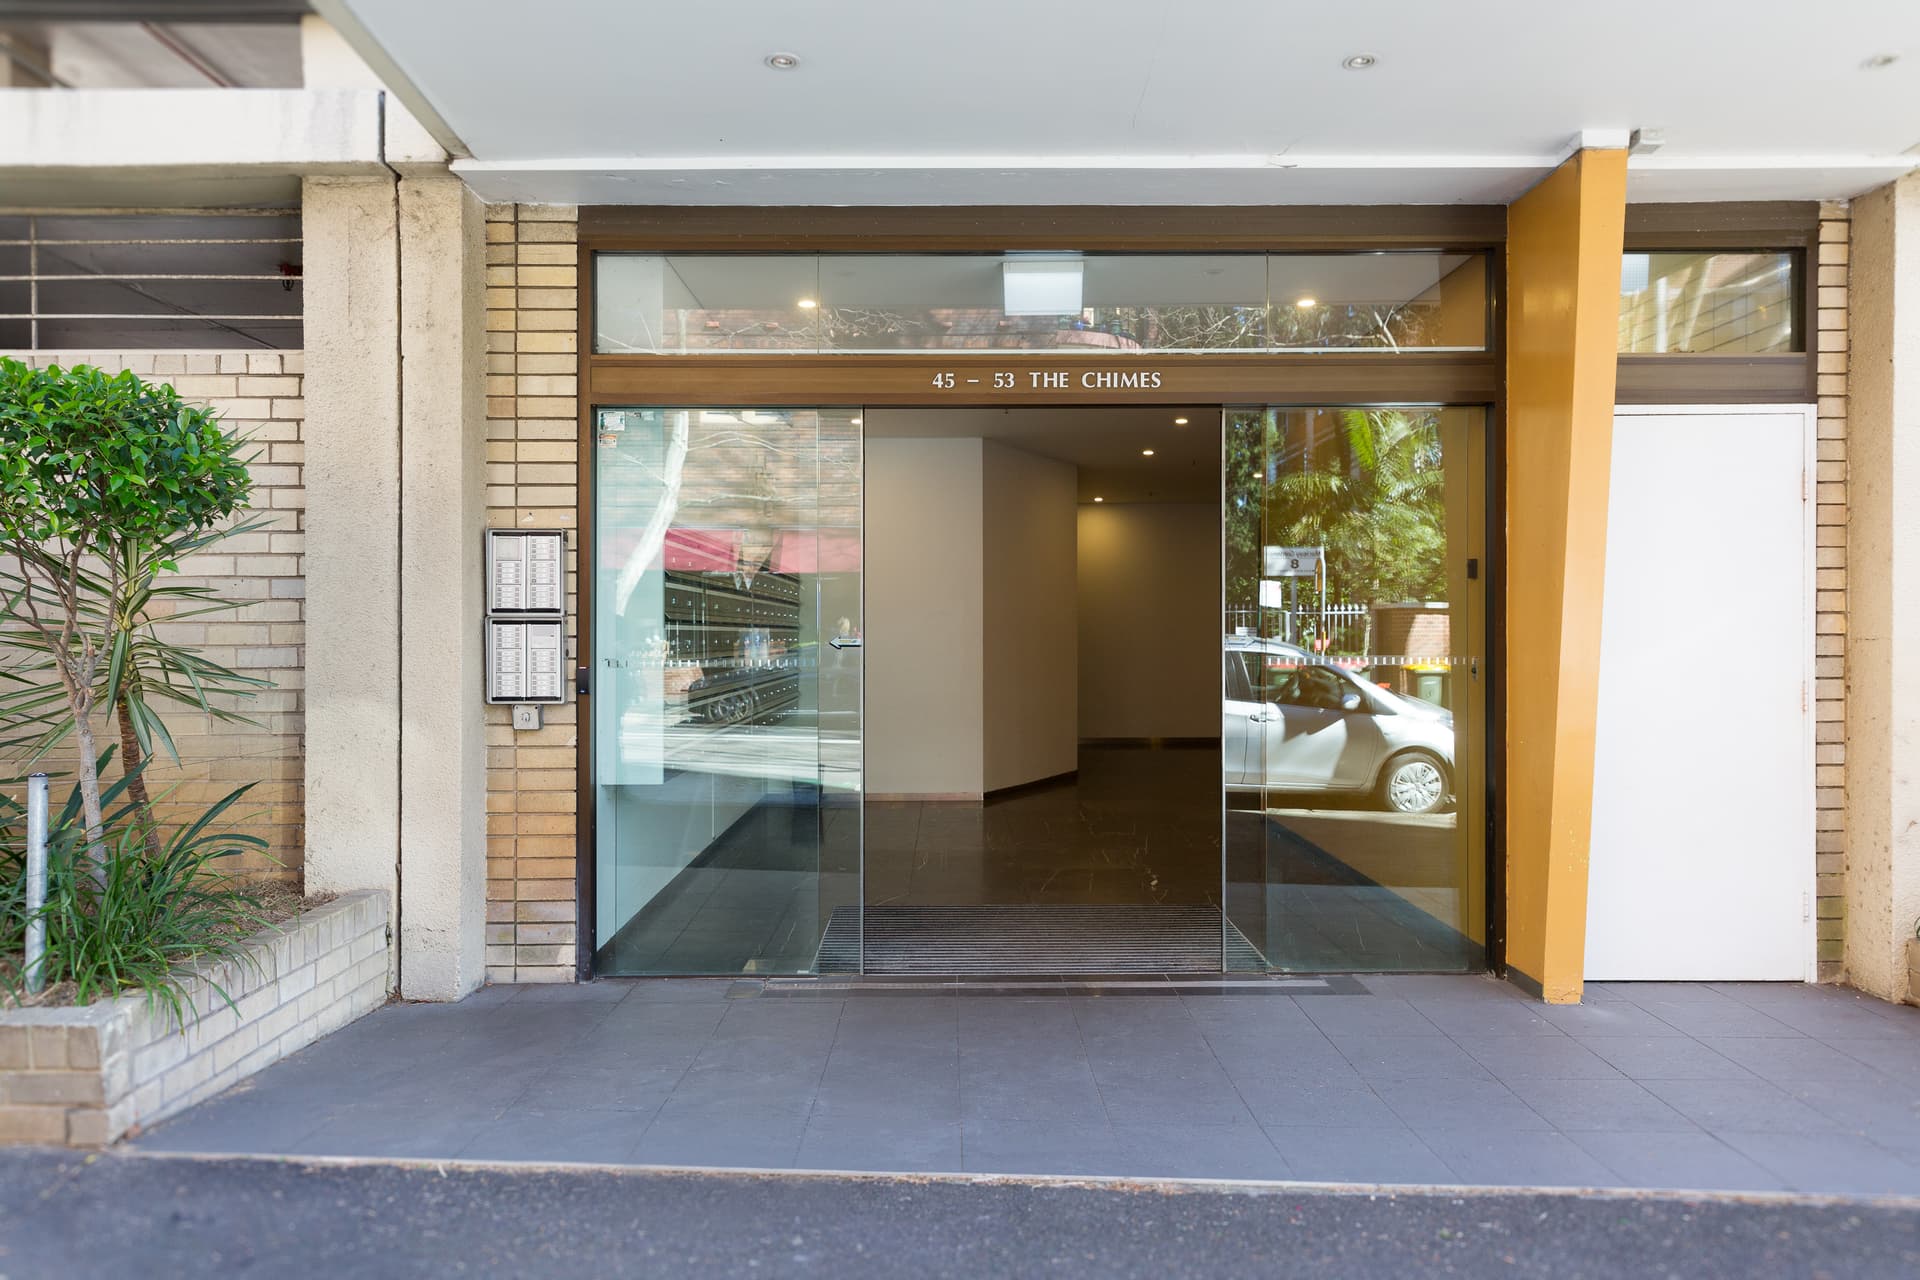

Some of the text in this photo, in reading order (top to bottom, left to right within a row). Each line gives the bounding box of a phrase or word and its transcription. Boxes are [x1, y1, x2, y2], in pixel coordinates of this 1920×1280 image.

[931, 372, 955, 389] 45
[993, 372, 1015, 389] 53
[1029, 371, 1069, 389] THE
[1081, 371, 1162, 389] CHIMES
